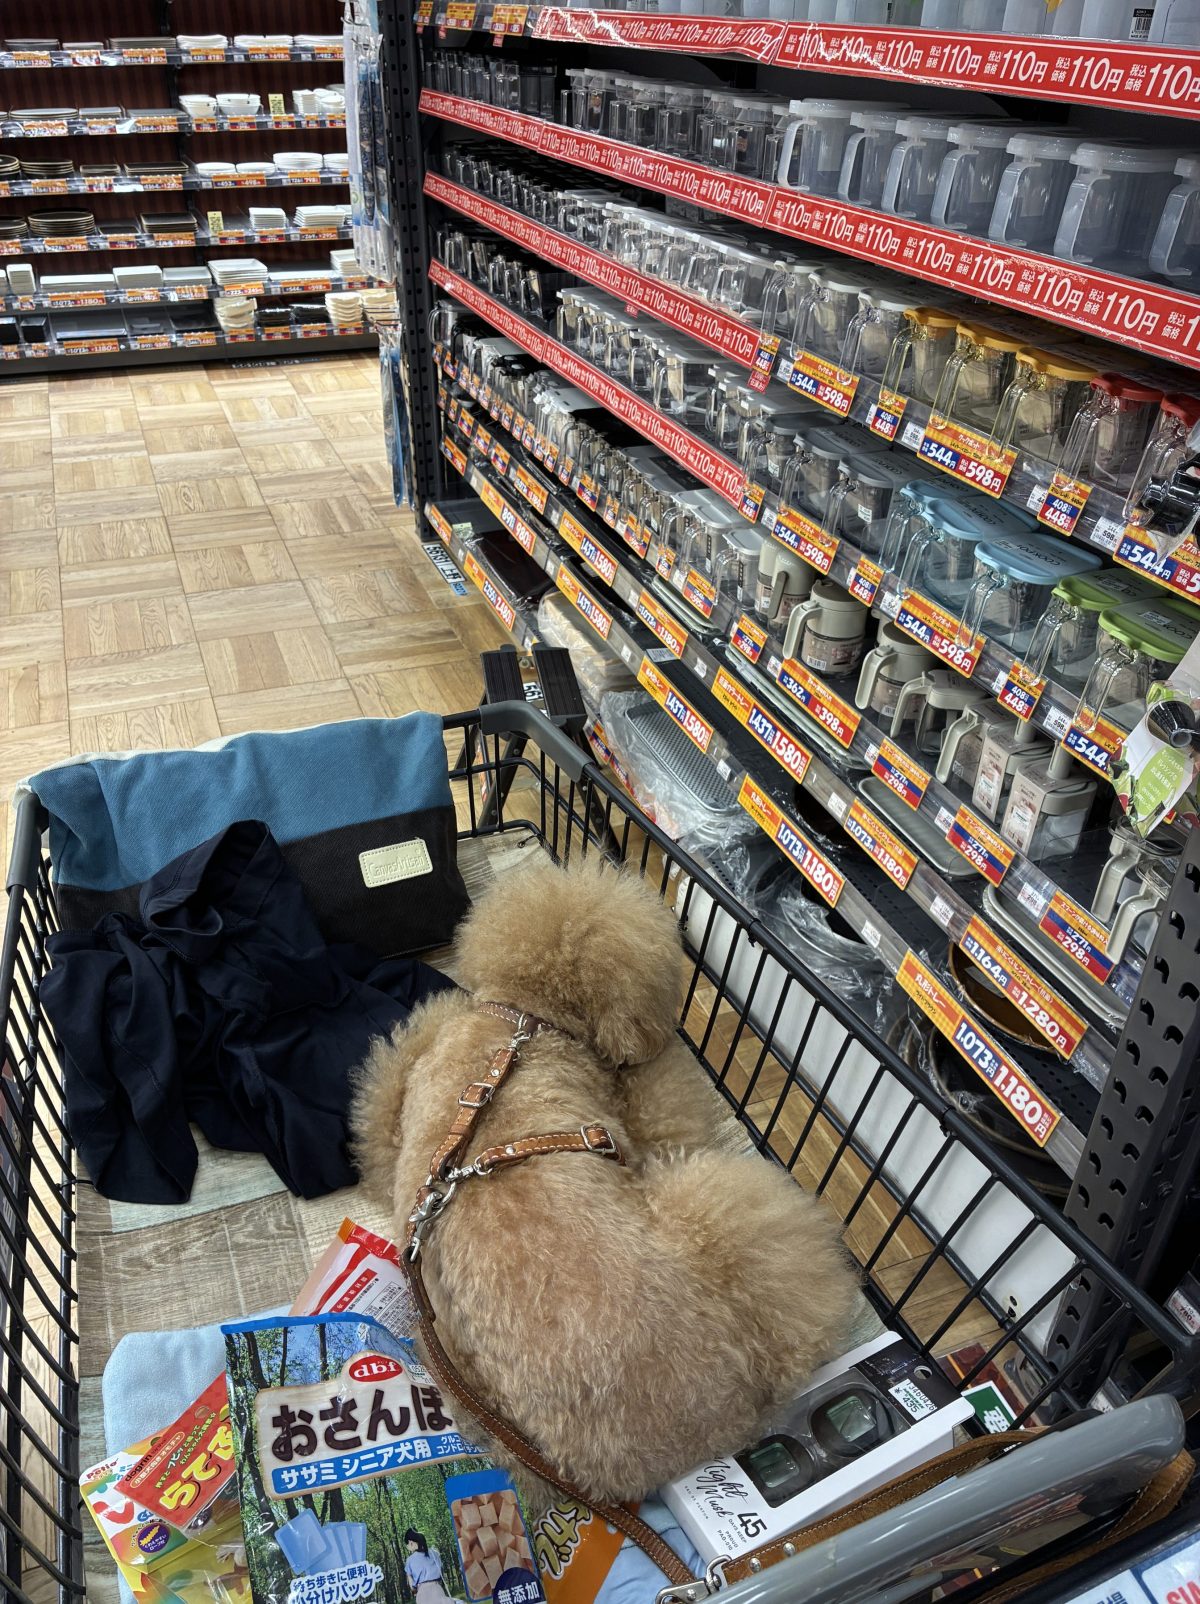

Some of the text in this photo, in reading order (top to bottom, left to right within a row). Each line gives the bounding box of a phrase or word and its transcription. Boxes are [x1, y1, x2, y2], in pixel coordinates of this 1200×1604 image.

[653, 22, 674, 40] 110円
[679, 22, 704, 42] 110円
[709, 24, 734, 45] 110円
[742, 26, 770, 50] 110円
[838, 36, 872, 62] 110円
[885, 40, 924, 70] 110円
[940, 44, 982, 76] 110円
[1000, 49, 1048, 84] 110円
[1069, 56, 1125, 92] 110円
[1129, 64, 1148, 78] 税込
[1124, 78, 1143, 92] 価格
[629, 156, 646, 178] 110円
[654, 162, 674, 184] 110円
[680, 170, 700, 196] 110円
[706, 178, 732, 205] 110円
[738, 188, 764, 216] 110円
[782, 200, 812, 230] 110円
[822, 211, 854, 242] 110円
[864, 224, 900, 257] 110円
[915, 238, 956, 273] 110円
[970, 252, 1016, 292] 110円
[1033, 271, 1084, 313] 110円
[1102, 291, 1160, 336] 110円
[1016, 282, 1032, 295] 価格
[1021, 270, 1036, 283] 税込
[1083, 302, 1101, 316] 価格
[1088, 288, 1104, 302] 税込
[650, 288, 668, 314] 110円
[675, 302, 694, 326] 110円
[701, 316, 724, 342] 110円
[731, 329, 754, 358] 110円
[1161, 326, 1180, 340] 価格
[1168, 312, 1186, 327] 税込
[795, 373, 817, 396] 544円
[823, 386, 848, 412] 598円
[695, 446, 715, 475] 110円
[928, 442, 956, 470] 544円
[965, 462, 1002, 492] 598円
[804, 542, 830, 570] 598円
[1128, 544, 1172, 581] 544円
[903, 614, 972, 672] 544円 598円
[786, 676, 807, 702] 362円
[819, 704, 845, 738] 398円
[1074, 736, 1108, 768] 544
[887, 772, 907, 798] 298円
[964, 844, 987, 872] 298円
[1062, 936, 1090, 966] 298円
[1071, 930, 1092, 953] 271円
[902, 1396, 920, 1413] 435
[125, 1454, 153, 1482] dogrin
[281, 1440, 432, 1489] ササミ シニア犬用
[737, 1512, 768, 1538] 45
[293, 1564, 368, 1593] 持ち歩きに便利
[498, 1582, 540, 1604] 無添加
